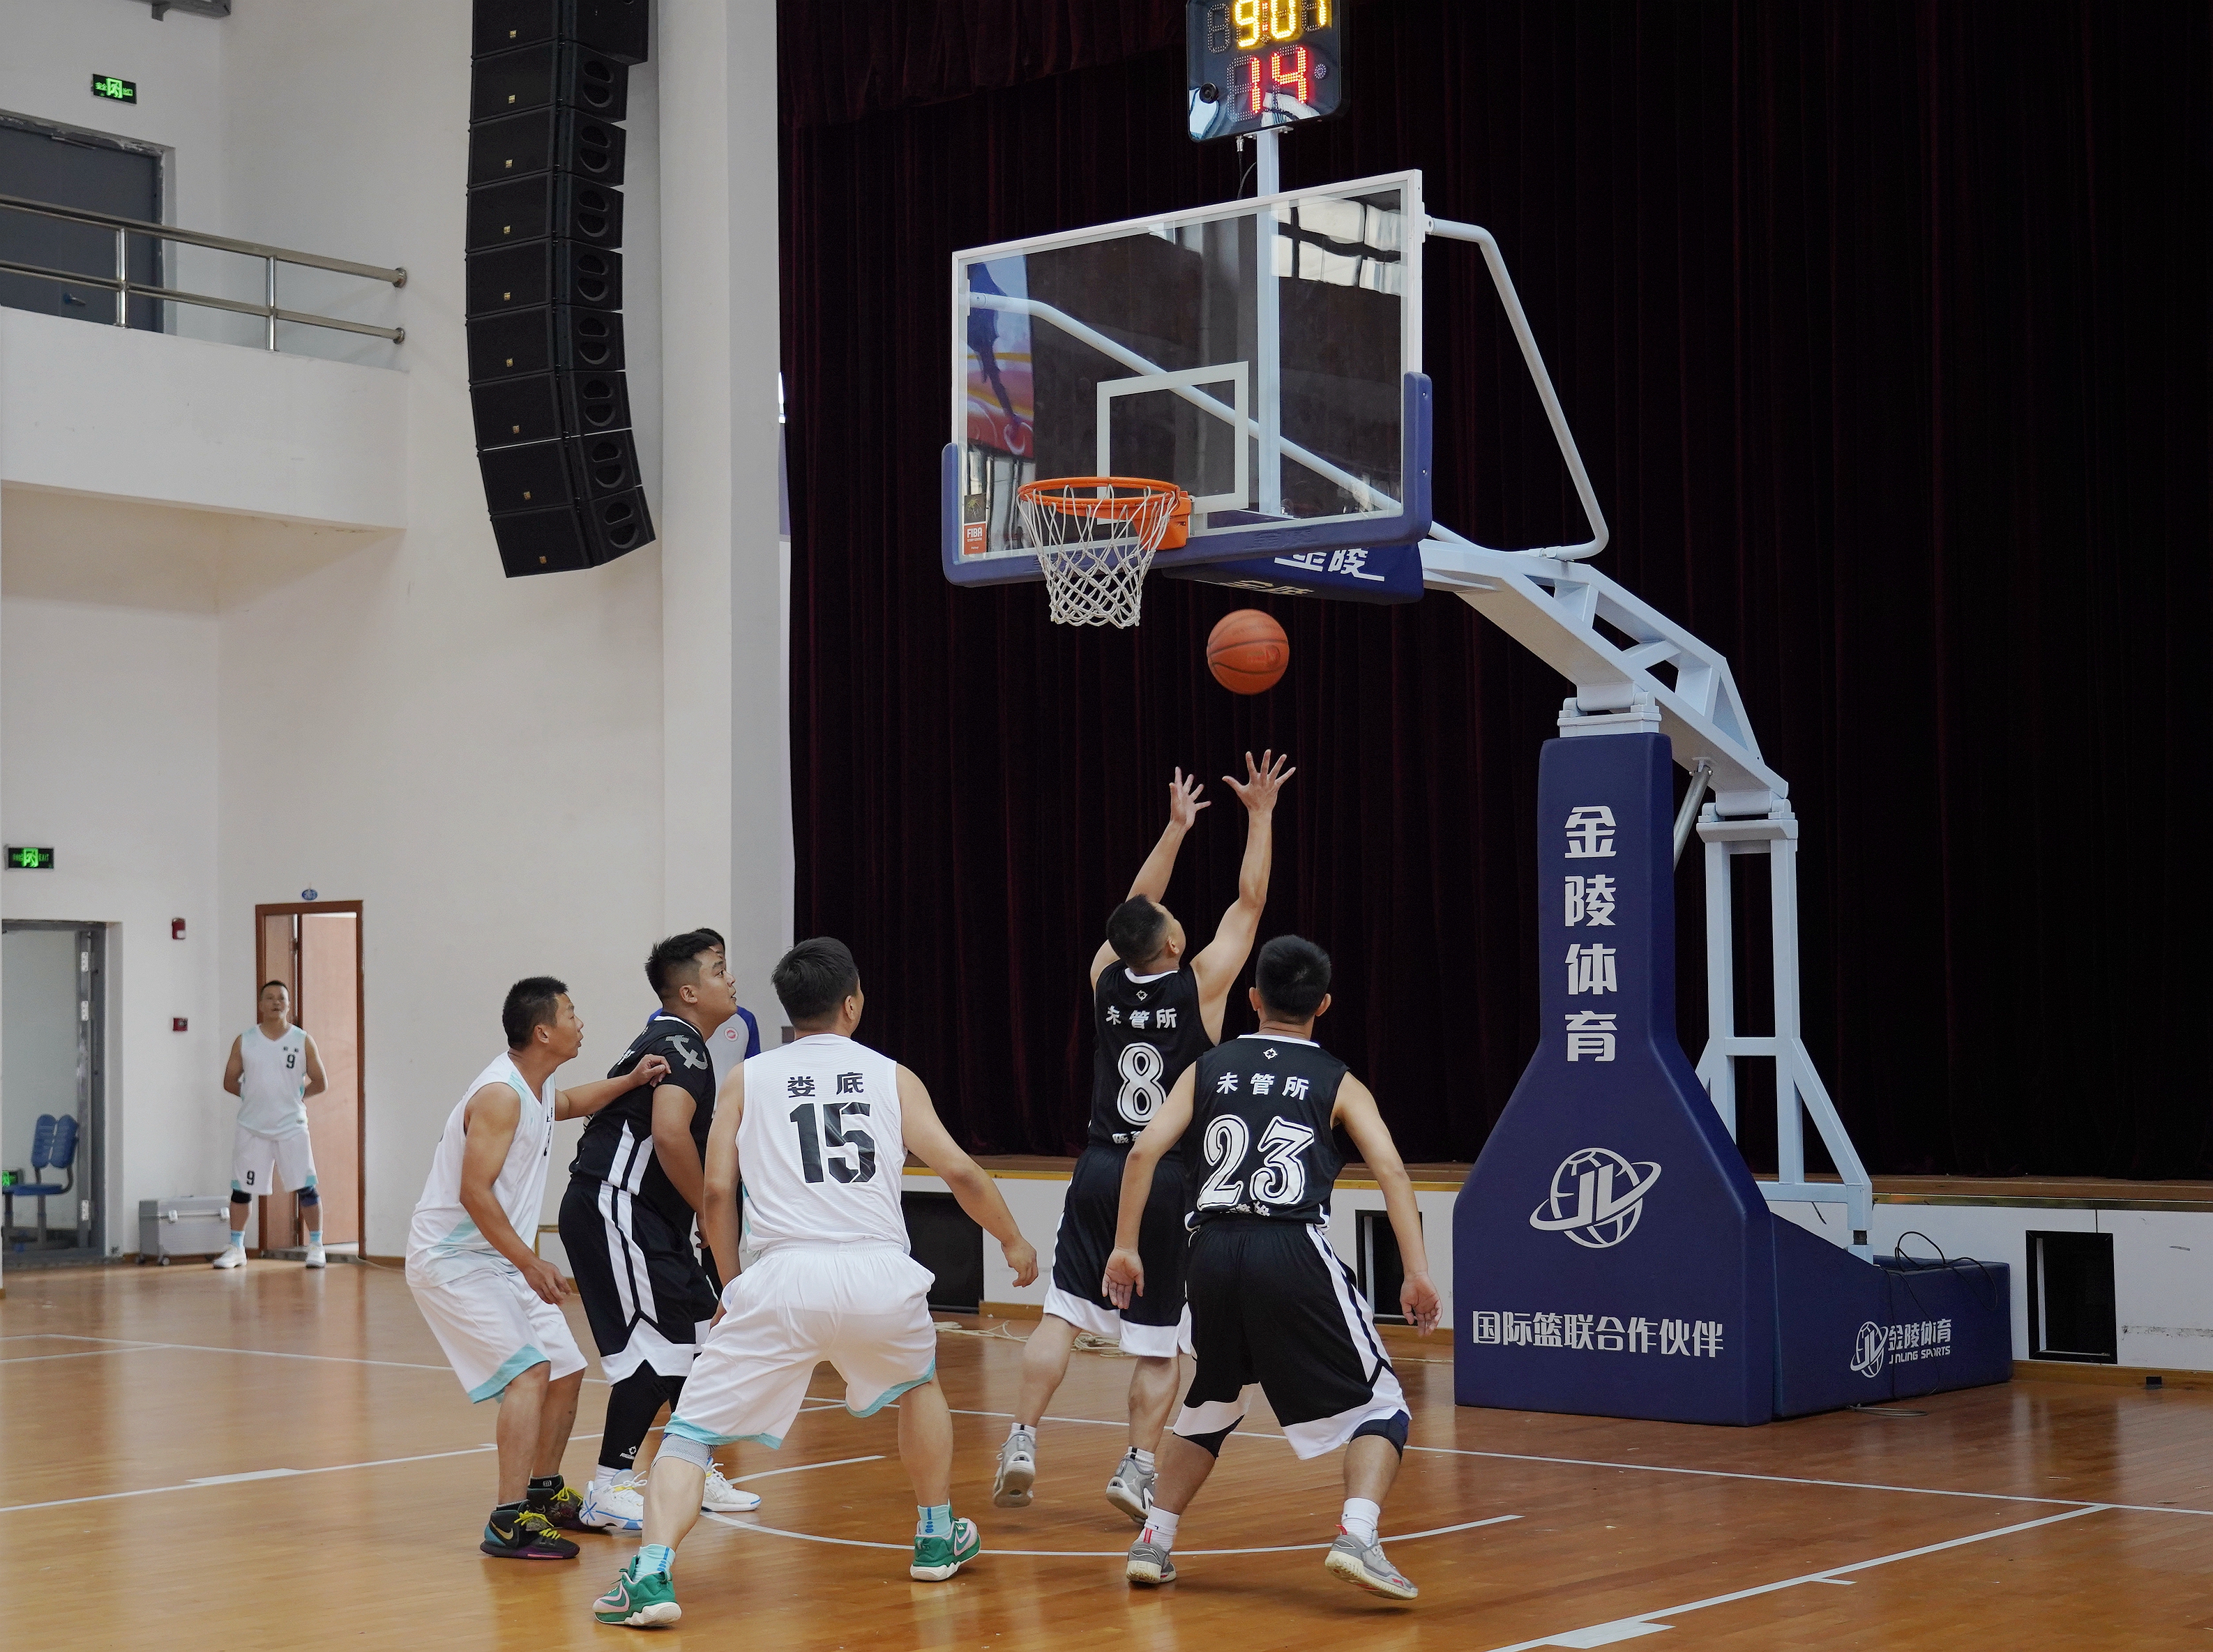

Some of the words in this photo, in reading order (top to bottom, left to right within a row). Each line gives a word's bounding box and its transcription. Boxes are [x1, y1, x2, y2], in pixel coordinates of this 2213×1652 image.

[1251, 46, 1307, 114] 14
[967, 527, 983, 538] FIBA
[1564, 805, 1618, 1063] 金陵体育
[1106, 1006, 1177, 1030] 未管所
[286, 1054, 296, 1069] 9
[787, 1072, 864, 1098] 娄底
[1117, 1042, 1168, 1127] 8
[1216, 1072, 1309, 1100] 未管所
[790, 1101, 877, 1184] 15
[1196, 1113, 1314, 1211] 23
[246, 1170, 255, 1185] 9
[1472, 1310, 1724, 1358] 国际篮联合作伙伴
[1888, 1318, 1952, 1351] 金陵体育
[1889, 1350, 1919, 1365] JNLING
[1920, 1345, 1951, 1360] SPORTS
